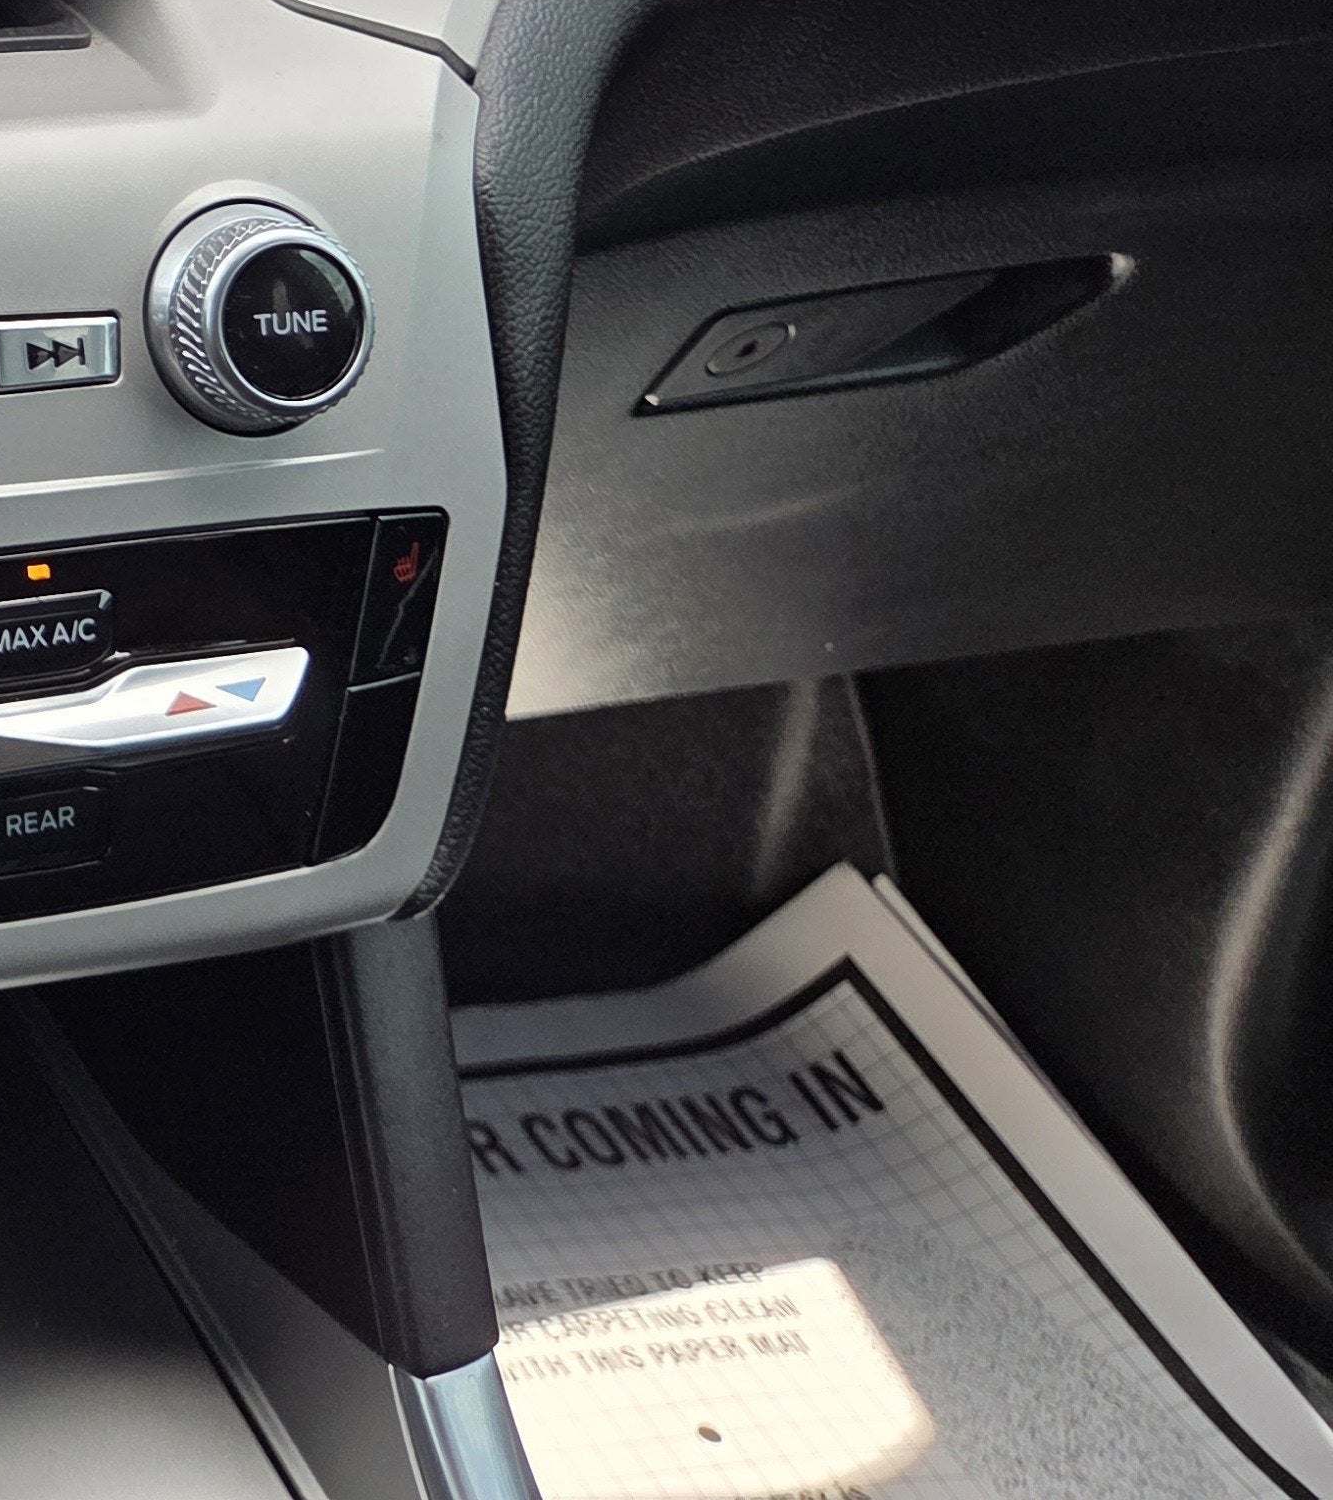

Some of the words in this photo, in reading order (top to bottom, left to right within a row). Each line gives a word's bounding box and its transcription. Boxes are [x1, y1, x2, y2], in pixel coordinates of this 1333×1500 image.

[252, 309, 329, 337] TUNE
[52, 617, 97, 645] A/C
[4, 805, 76, 837] REAR
[517, 1084, 800, 1173] COMING
[789, 1049, 887, 1134] IN
[696, 1260, 765, 1285] KEEP
[704, 1294, 803, 1326] CLEAN
[576, 1343, 646, 1374] THIS
[646, 1334, 747, 1367] PAPER
